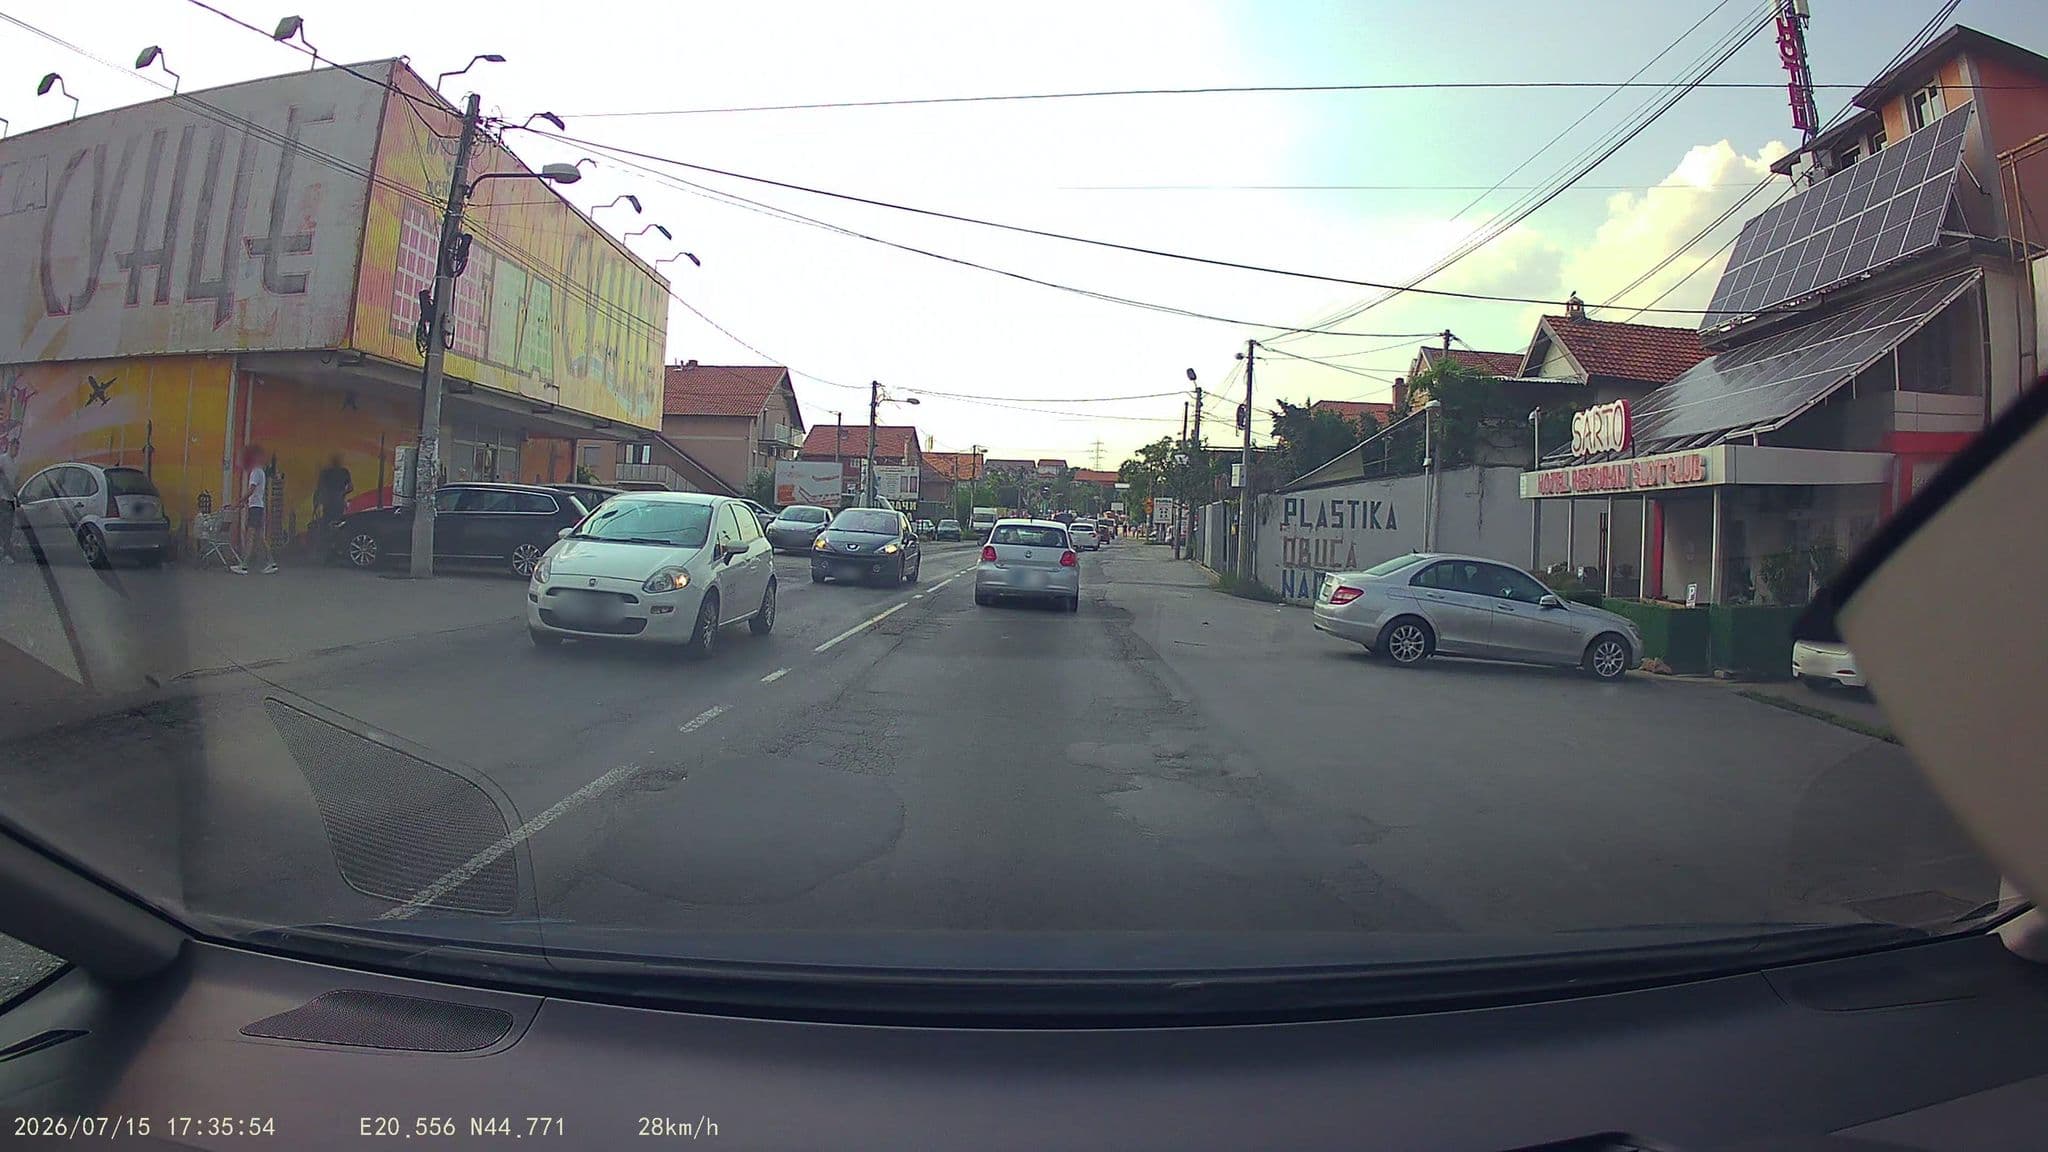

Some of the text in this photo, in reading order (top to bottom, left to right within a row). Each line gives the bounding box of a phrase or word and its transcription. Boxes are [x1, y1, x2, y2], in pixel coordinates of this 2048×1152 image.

[1572, 402, 1625, 455] SARTO
[1538, 470, 1570, 494] HOTEL
[1667, 453, 1706, 484] CLUB
[1284, 499, 1397, 529] PLASTIKA
